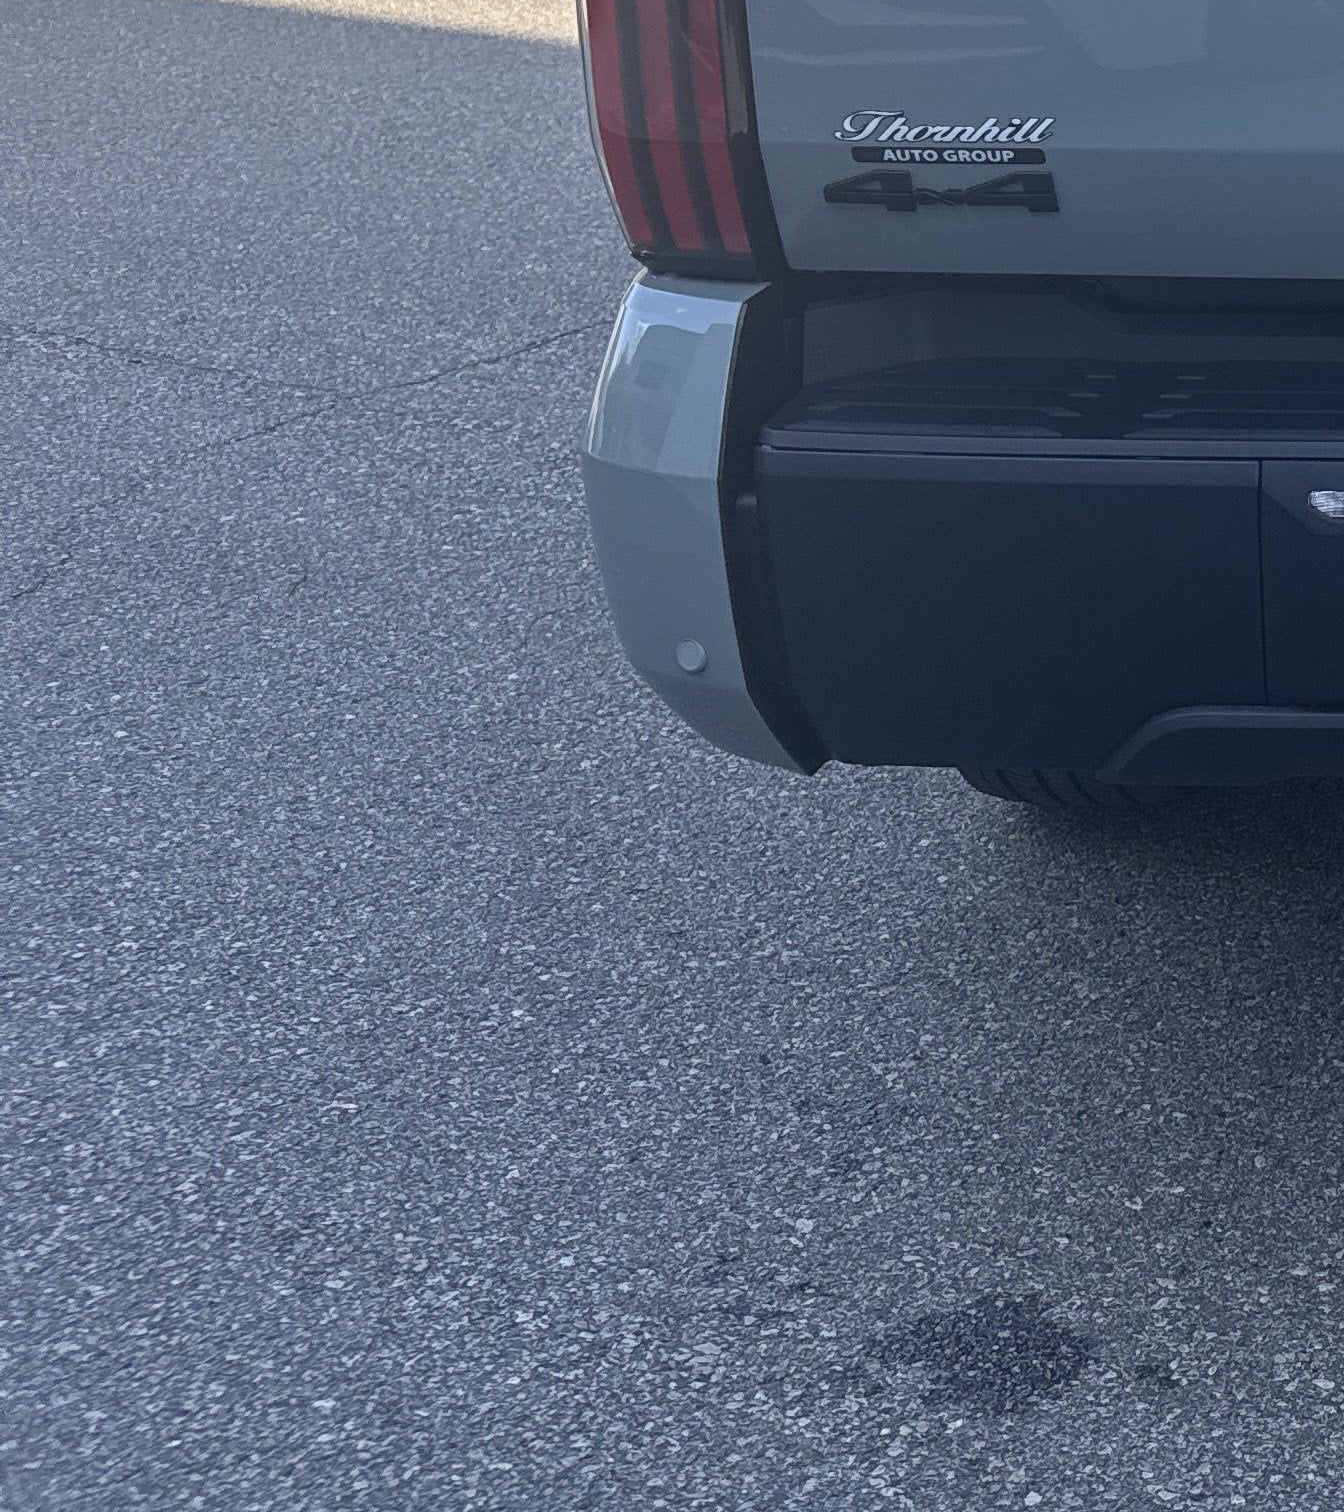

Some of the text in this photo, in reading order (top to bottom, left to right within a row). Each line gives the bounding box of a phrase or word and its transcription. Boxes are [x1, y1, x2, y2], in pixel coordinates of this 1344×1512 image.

[833, 109, 1056, 144] Thornhill
[882, 148, 1016, 164] AUTO GROUP
